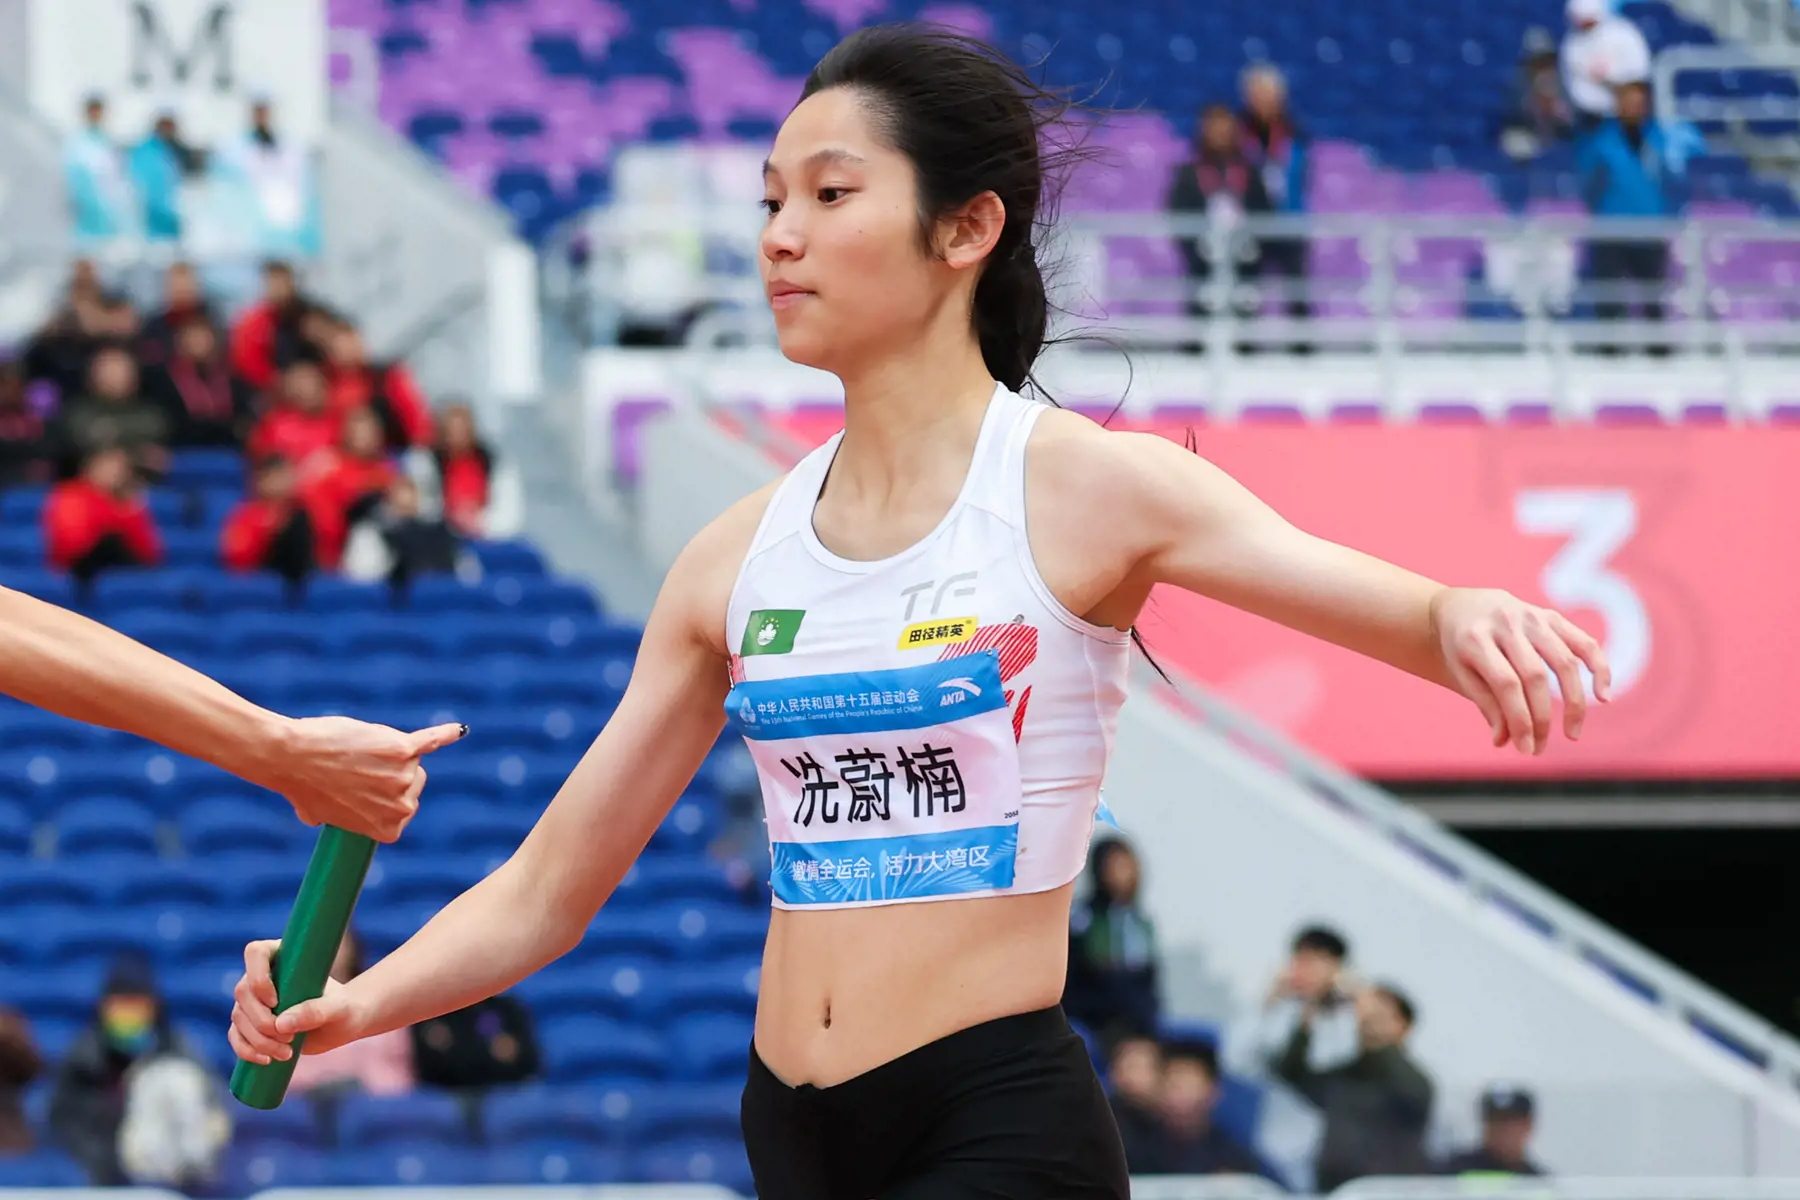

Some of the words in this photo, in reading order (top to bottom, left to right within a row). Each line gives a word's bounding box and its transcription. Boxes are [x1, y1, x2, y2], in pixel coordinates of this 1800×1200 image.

[1513, 487, 1651, 704] 3
[909, 623, 964, 643] 田径精英
[758, 688, 920, 715] 中华人民共和国第十五届运动会
[940, 690, 966, 707] ANTA
